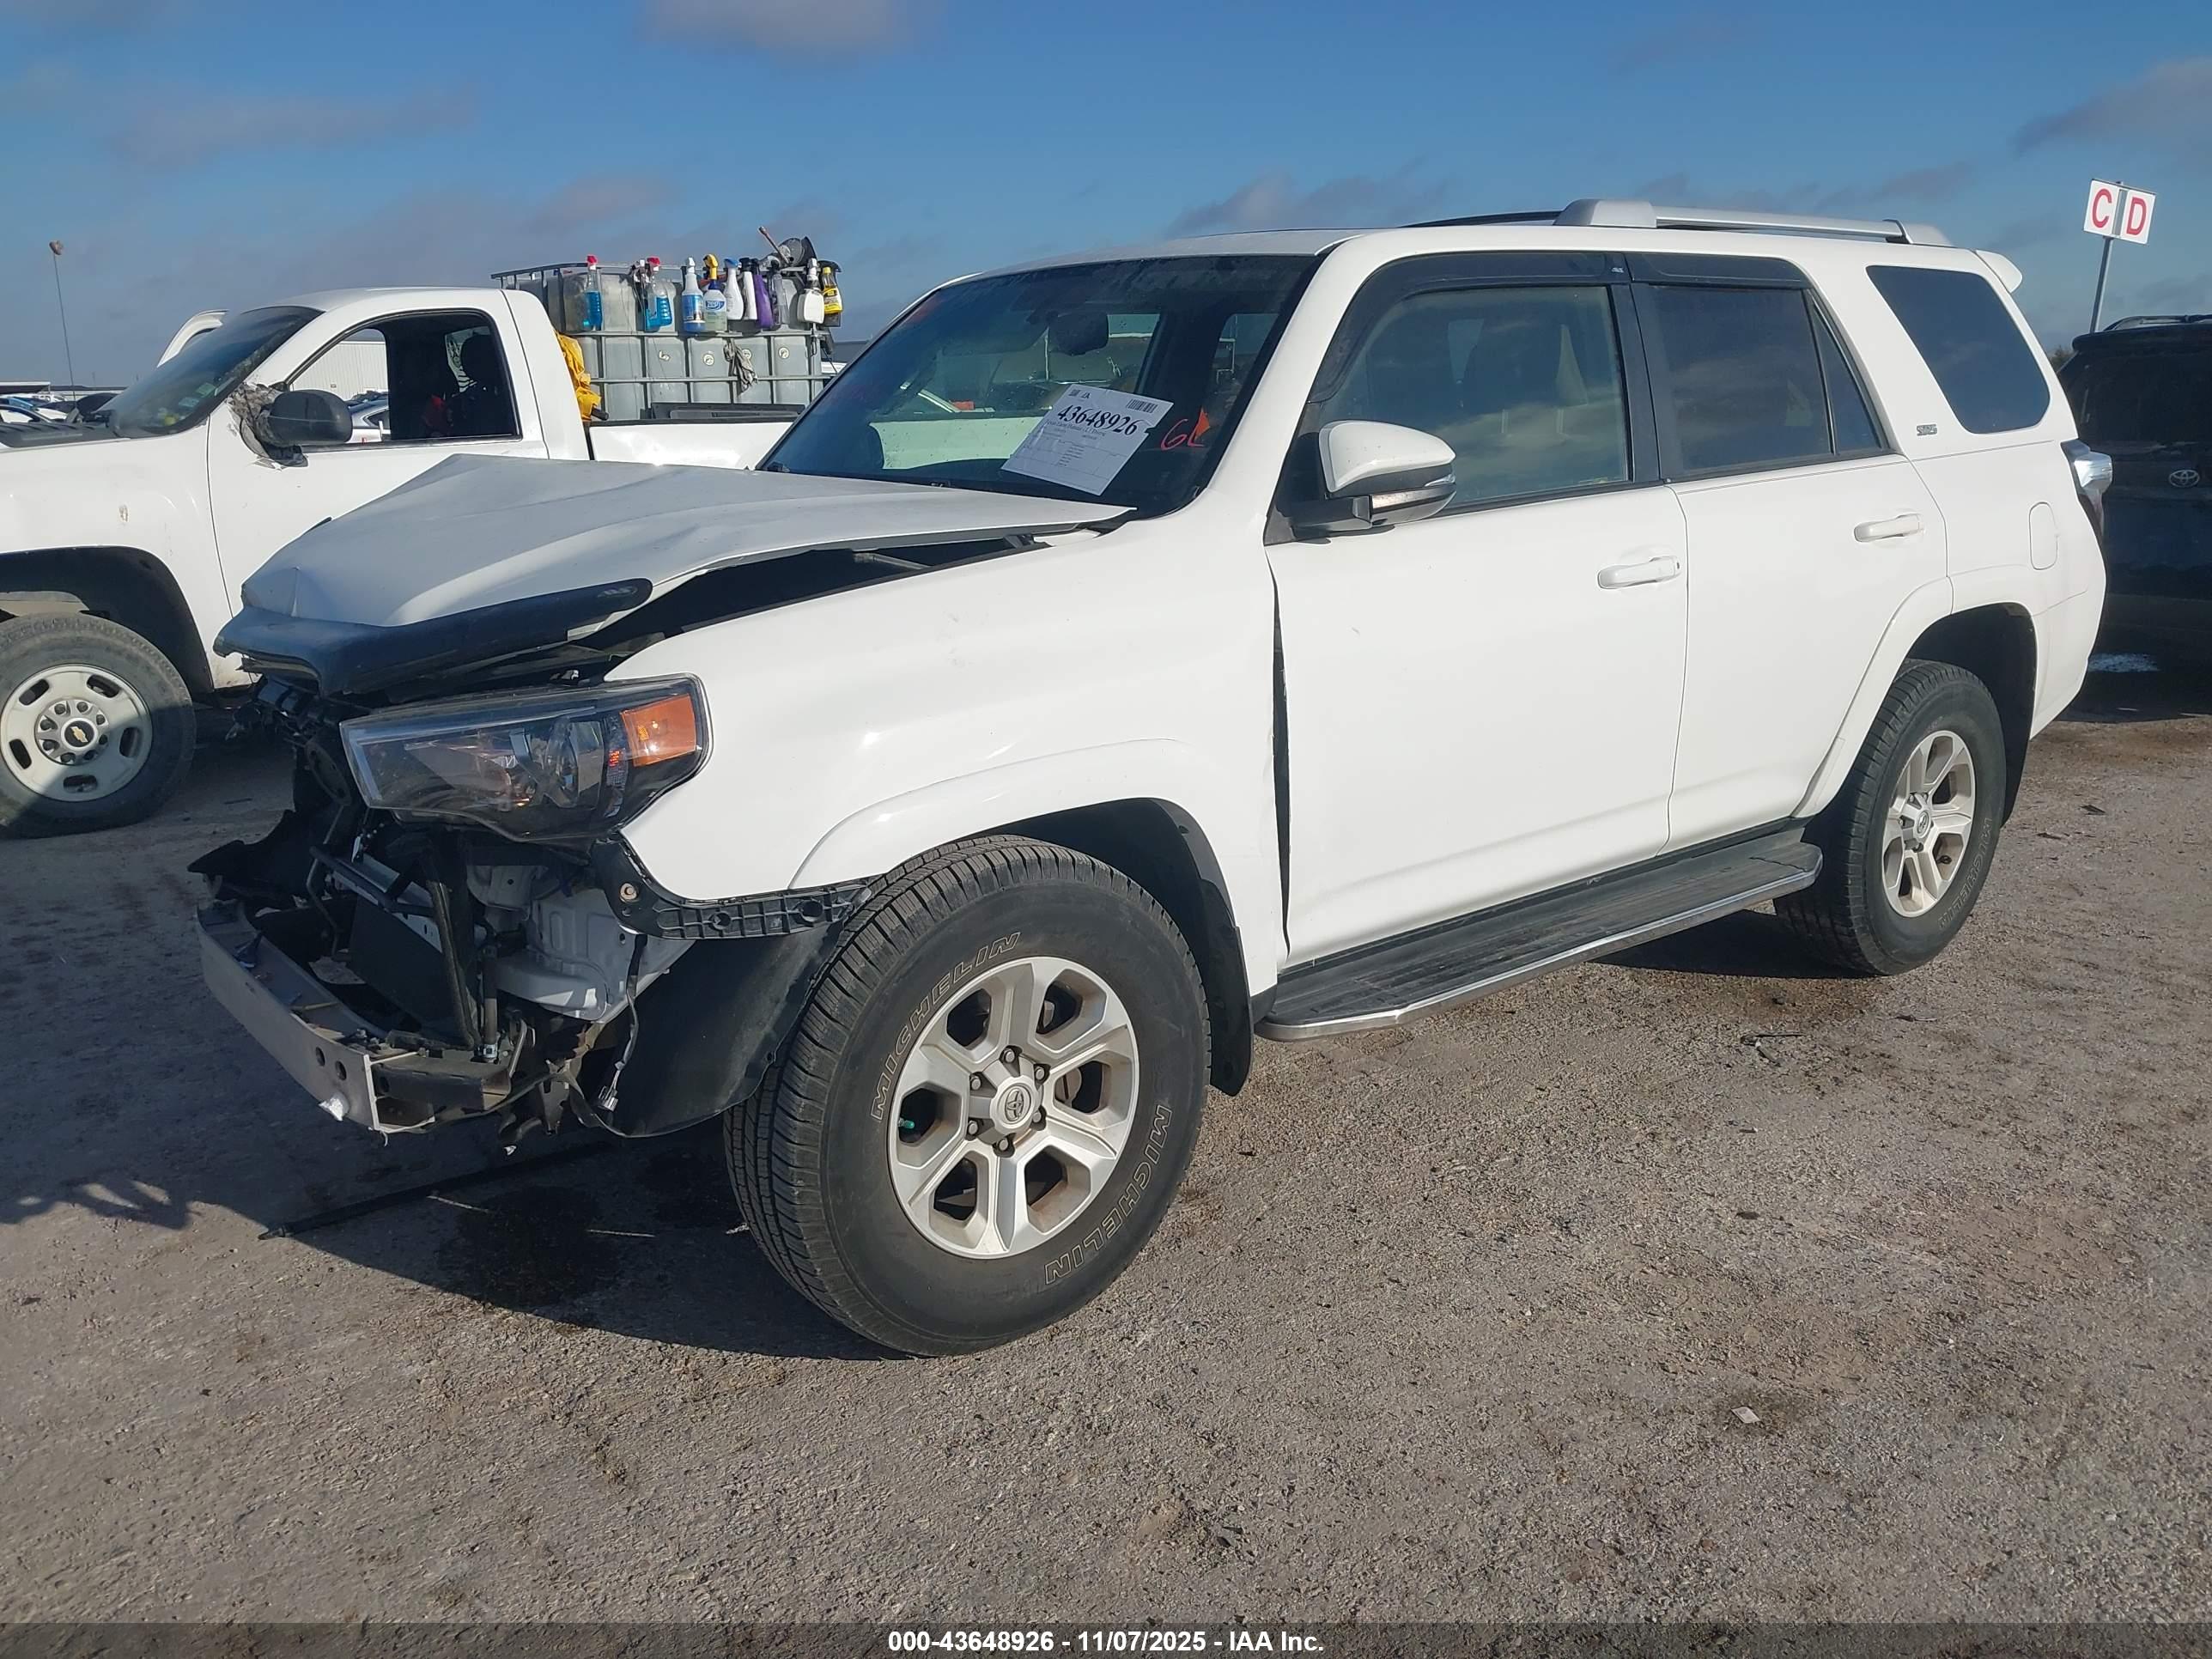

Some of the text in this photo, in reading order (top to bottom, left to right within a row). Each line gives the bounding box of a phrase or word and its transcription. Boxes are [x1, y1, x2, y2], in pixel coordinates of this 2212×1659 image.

[2092, 188, 2147, 236] C D
[1057, 404, 1144, 436] 43648926
[870, 930, 1021, 1122] MICHELIN
[1044, 1104, 1173, 1285] MICHELIN
